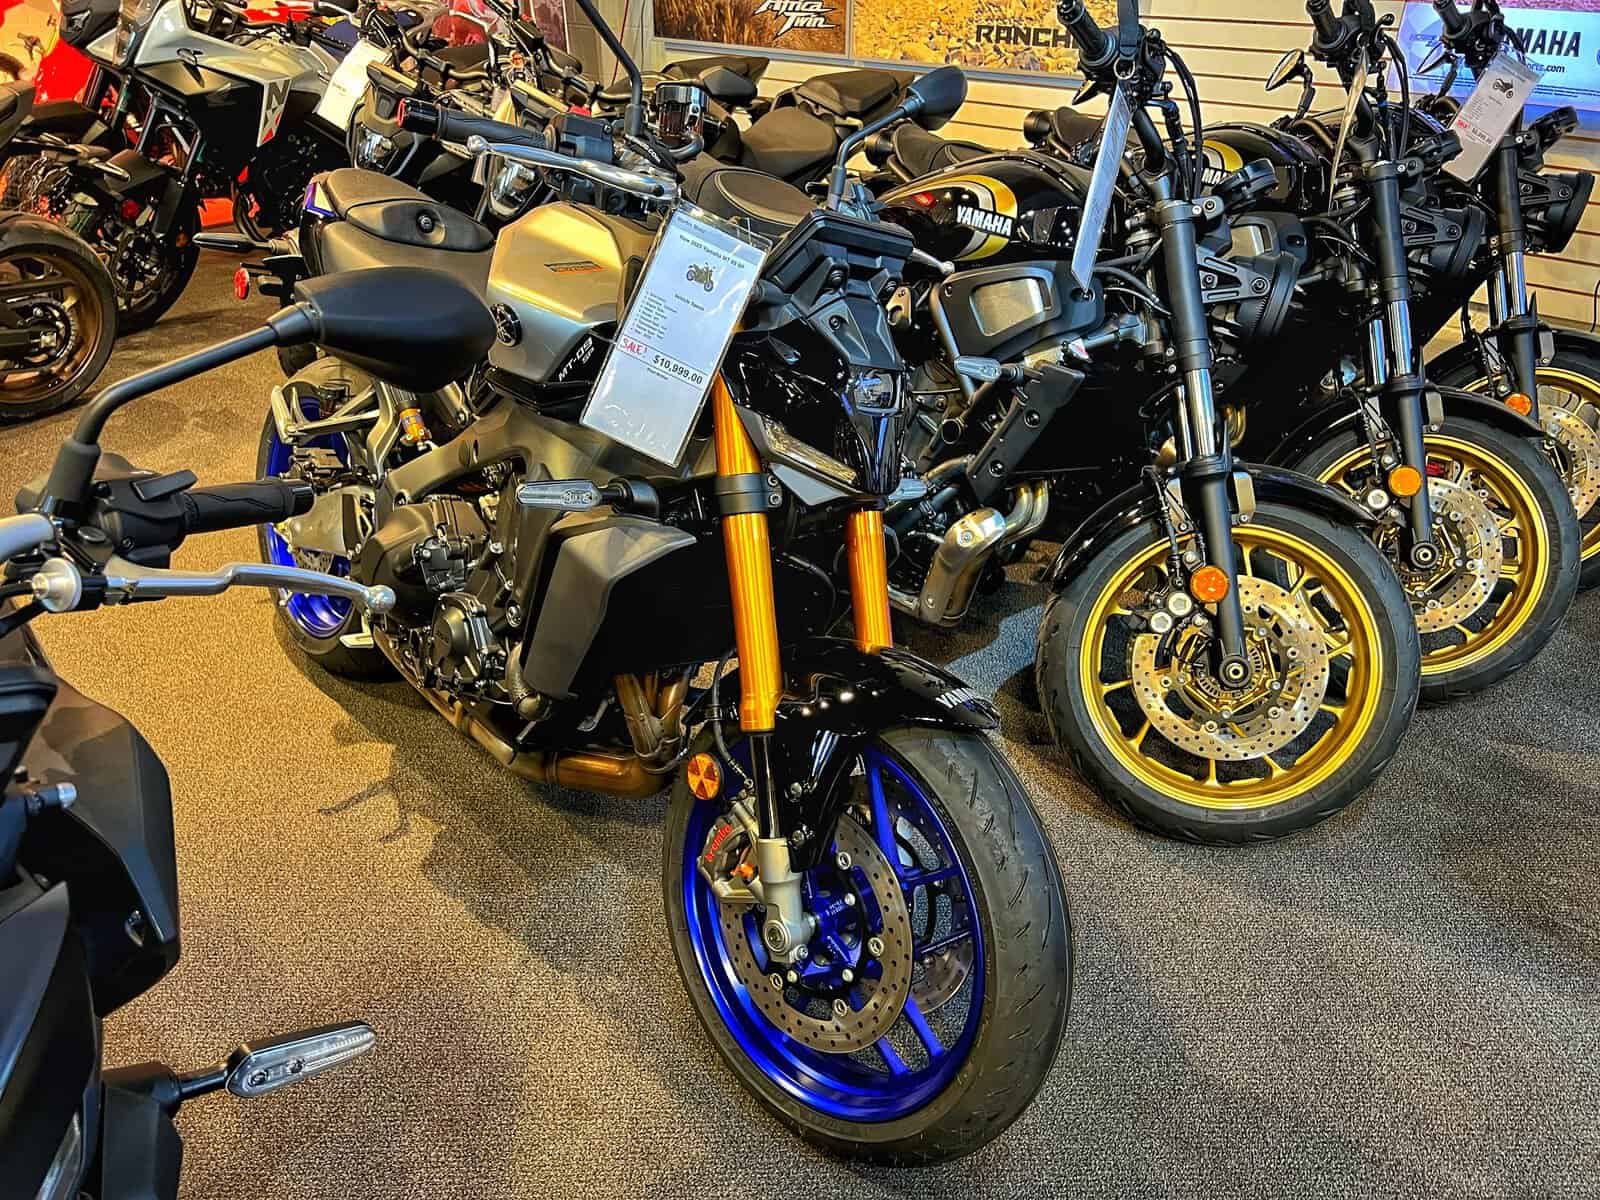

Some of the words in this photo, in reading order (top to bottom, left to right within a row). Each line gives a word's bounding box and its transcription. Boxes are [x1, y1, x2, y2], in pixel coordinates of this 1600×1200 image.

[773, 12, 838, 39] Twin
[976, 25, 1079, 49] RANCH
[1516, 28, 1581, 57] MAHA
[957, 204, 1013, 236] YAMAHA
[558, 336, 593, 382] MT-09
[652, 354, 703, 385] $10,999.00
